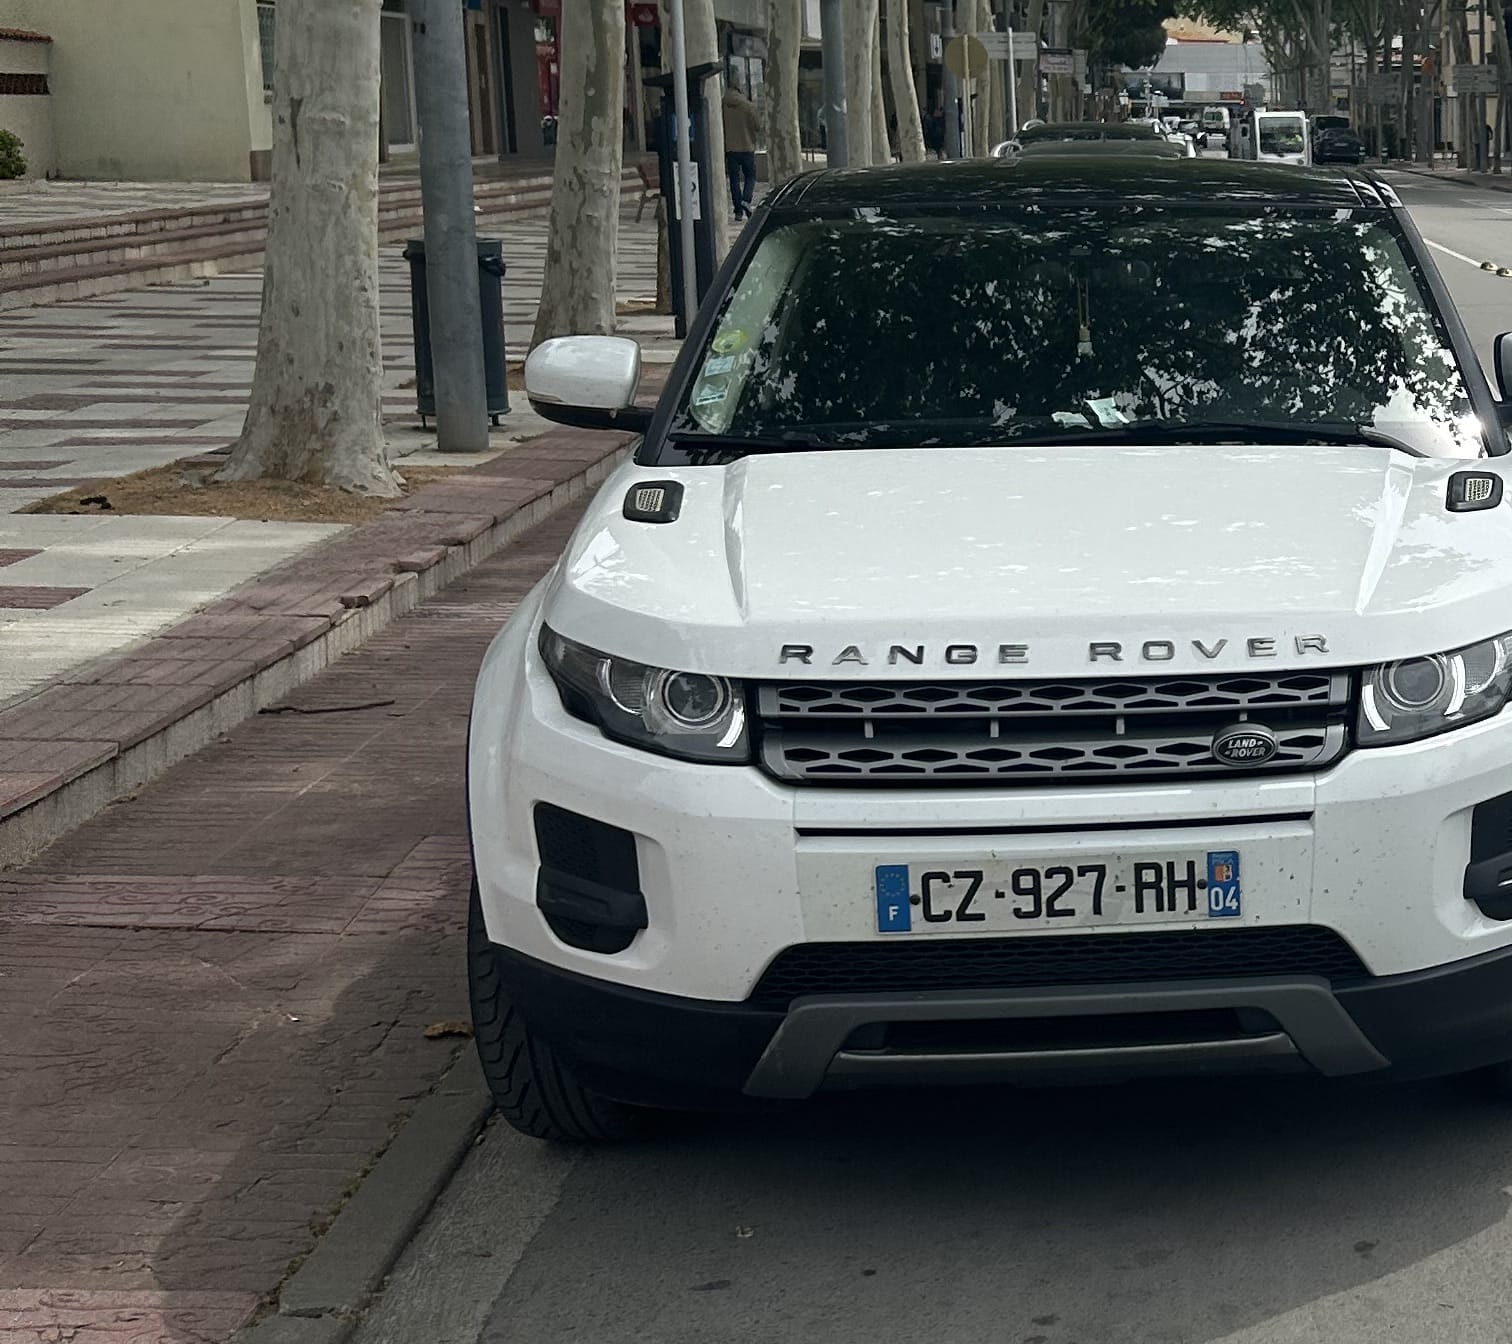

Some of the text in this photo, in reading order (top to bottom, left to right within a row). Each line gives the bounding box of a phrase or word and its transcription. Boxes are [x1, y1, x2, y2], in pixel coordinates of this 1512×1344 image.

[778, 635, 1331, 665] RANGE ROVER
[1210, 886, 1239, 911] 04
[888, 905, 900, 921] F
